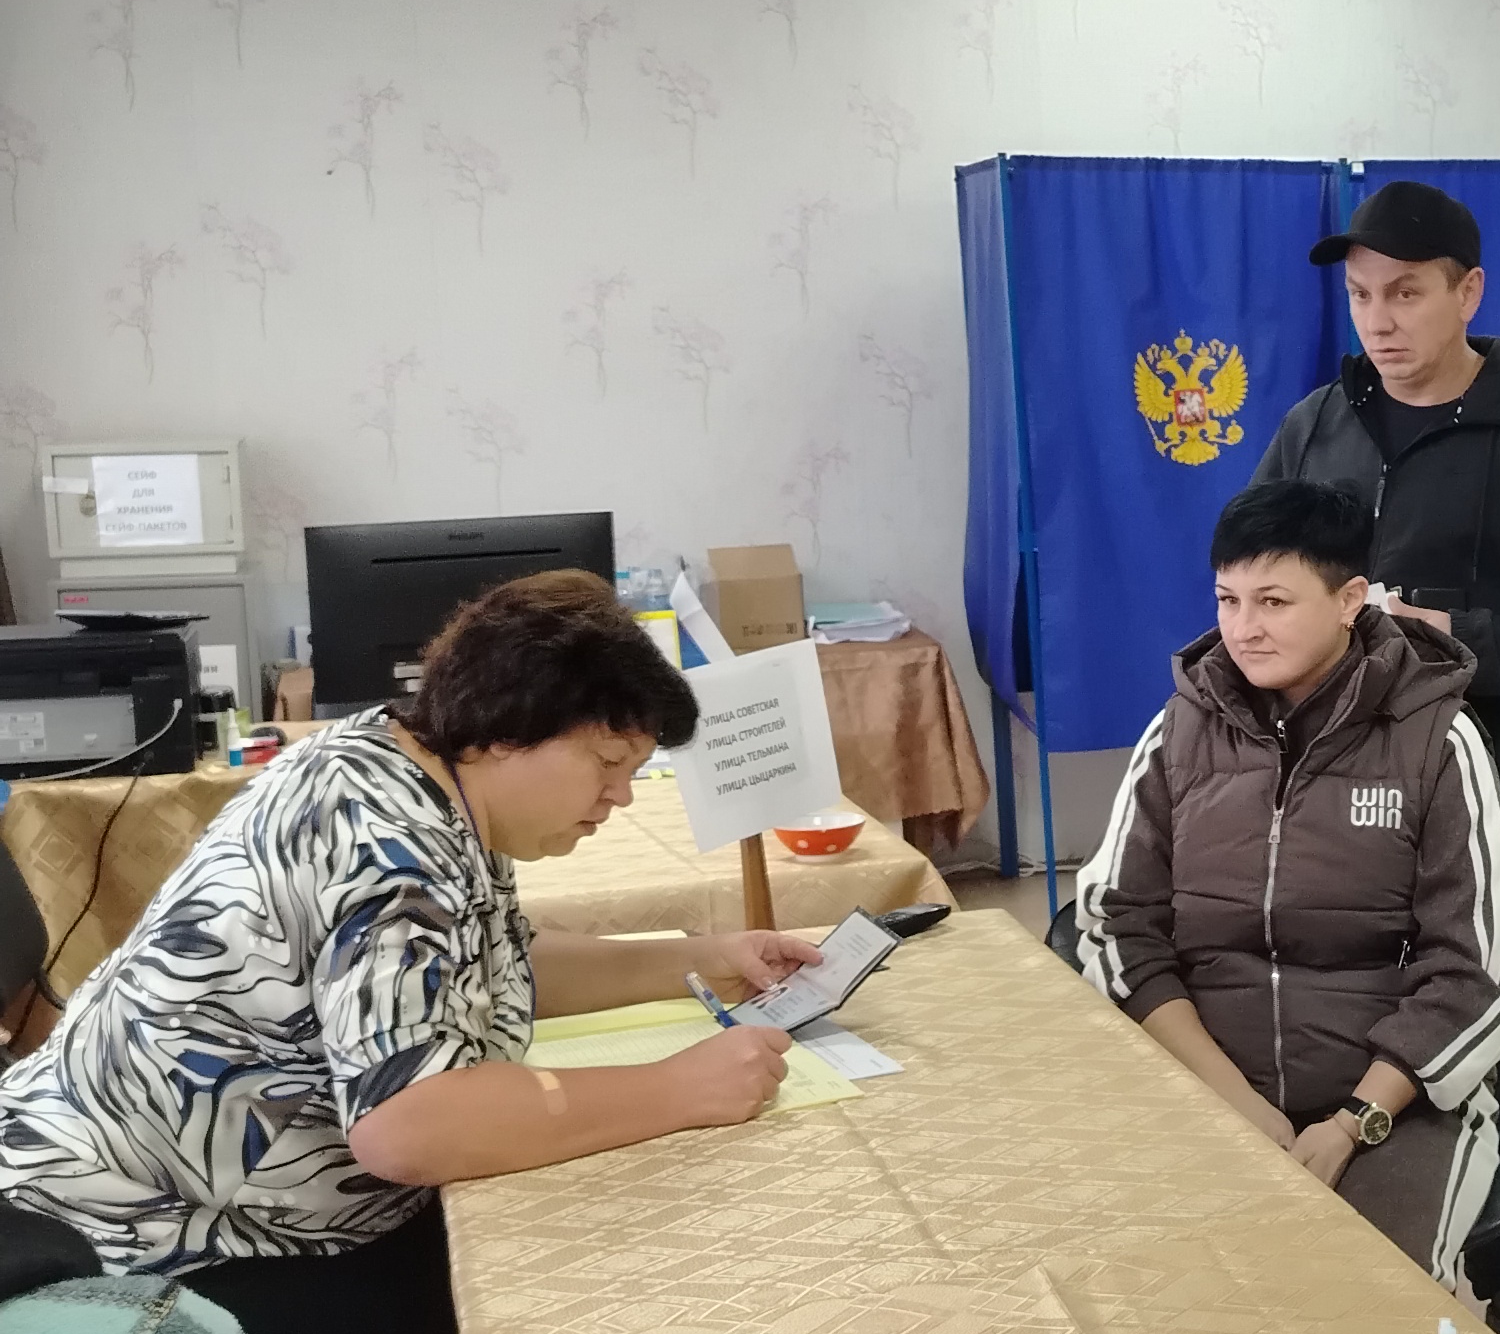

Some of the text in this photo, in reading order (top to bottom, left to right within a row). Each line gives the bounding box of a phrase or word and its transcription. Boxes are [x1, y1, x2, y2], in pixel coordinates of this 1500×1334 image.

[703, 698, 779, 728] УЛИЦА СОВЕТСКАЯ
[705, 717, 786, 751] УЛИЦА СТРОИТЕЛЕЙ
[714, 742, 789, 772] УЛИЦА ТЕЛЬМАНА
[716, 777, 748, 796] УЛИЦА
